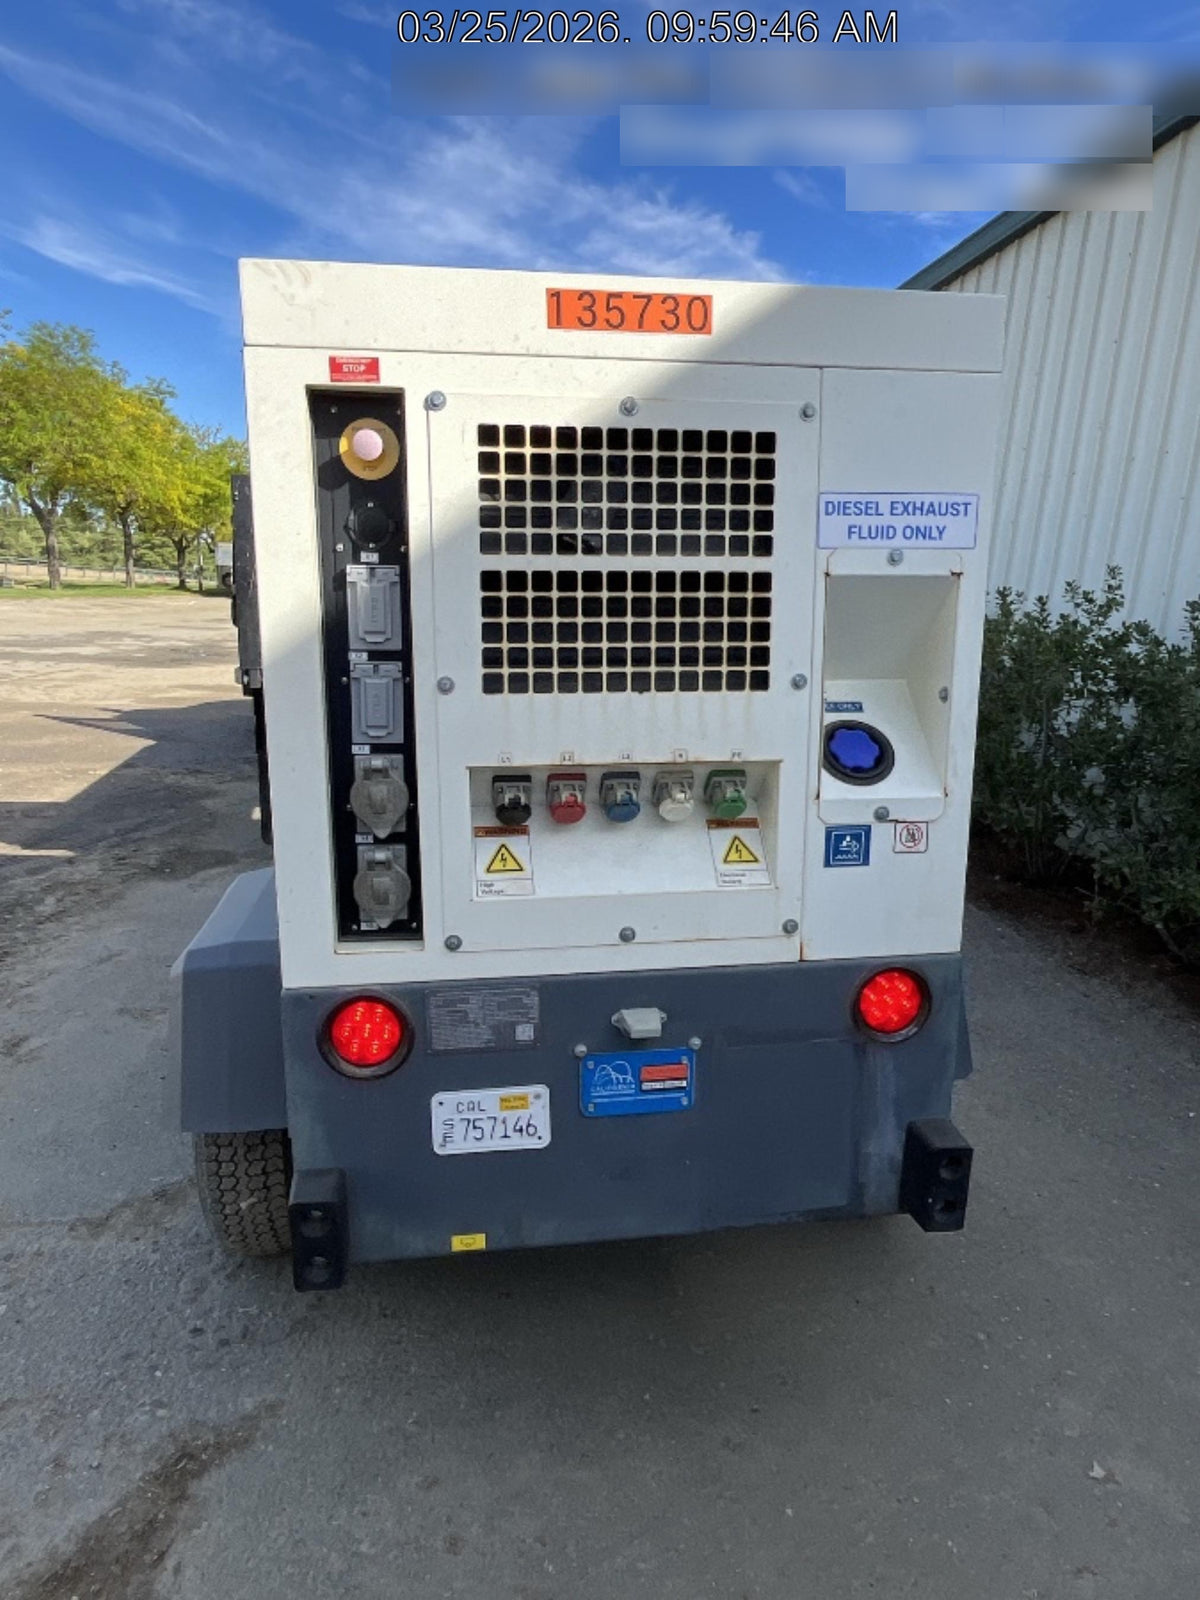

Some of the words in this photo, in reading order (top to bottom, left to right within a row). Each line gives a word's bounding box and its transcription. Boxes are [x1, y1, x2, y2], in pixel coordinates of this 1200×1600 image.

[549, 290, 709, 332] 135730
[342, 363, 367, 373] STOP
[824, 500, 884, 516] DIESEL
[890, 501, 972, 517] EXHAUST
[847, 524, 897, 540] FLUID
[902, 525, 947, 541] ONLY
[456, 1100, 487, 1114] CAL
[460, 1114, 538, 1141] 757146
